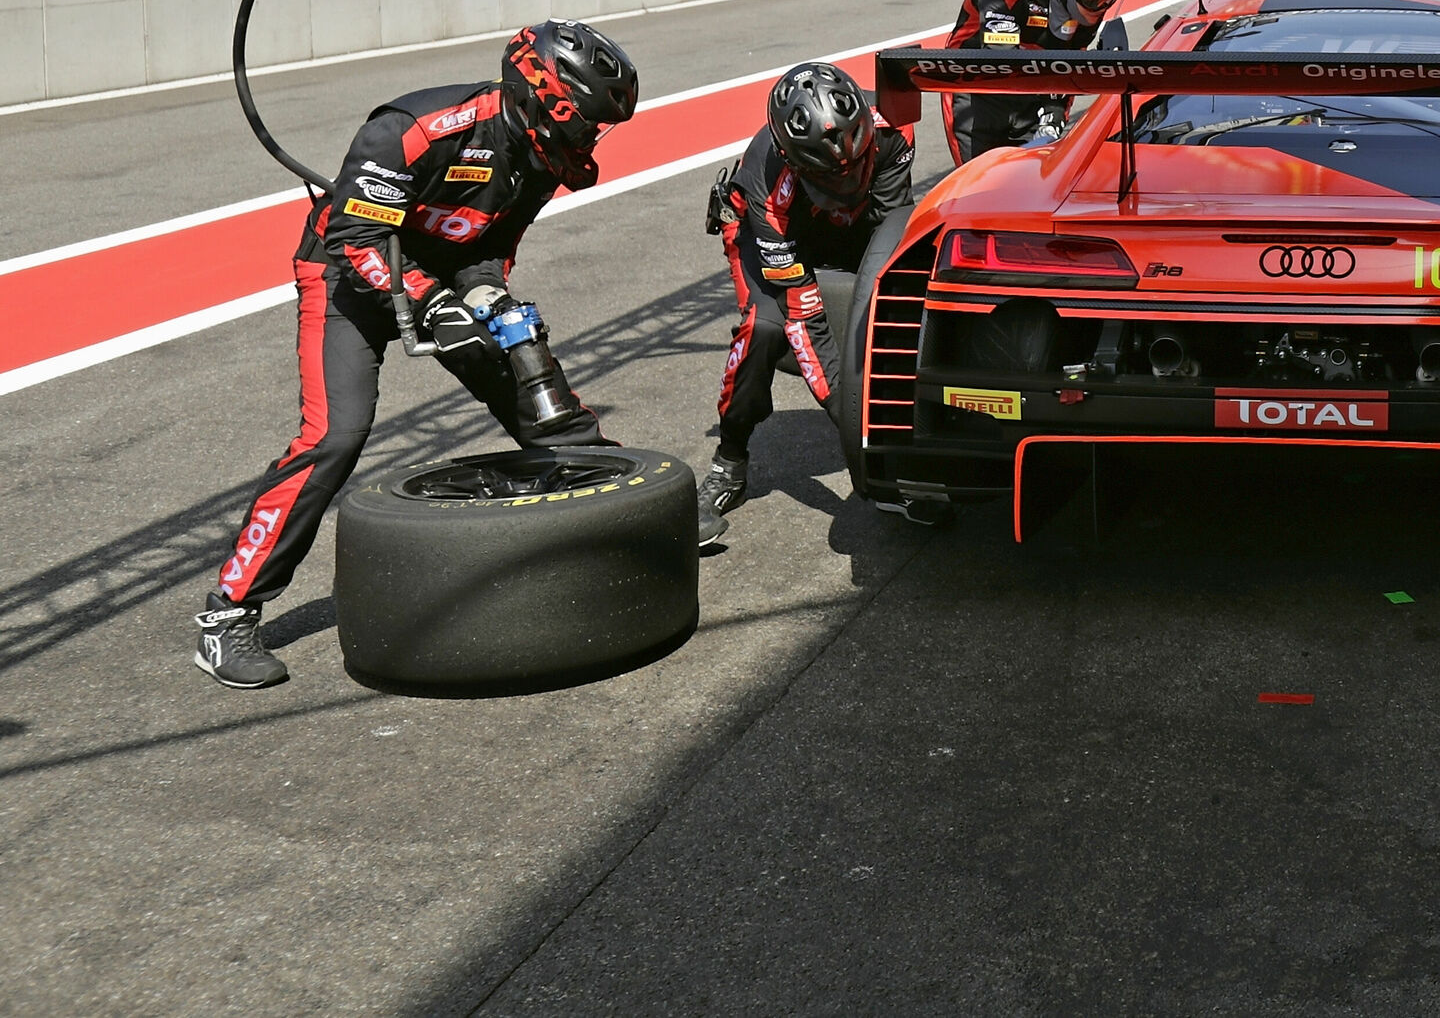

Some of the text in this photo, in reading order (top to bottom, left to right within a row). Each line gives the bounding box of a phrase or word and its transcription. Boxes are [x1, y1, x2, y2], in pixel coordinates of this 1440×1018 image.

[917, 56, 1013, 76] Pièces
[1021, 59, 1165, 78] d'Origine
[438, 106, 477, 130] WRT
[461, 148, 494, 160] WRT
[361, 160, 414, 182] Snap-on
[450, 169, 488, 180] PIRELLI
[352, 204, 399, 222] PIRELLI
[950, 392, 1014, 415] PIRELLI
[1228, 398, 1374, 427] TOTAL
